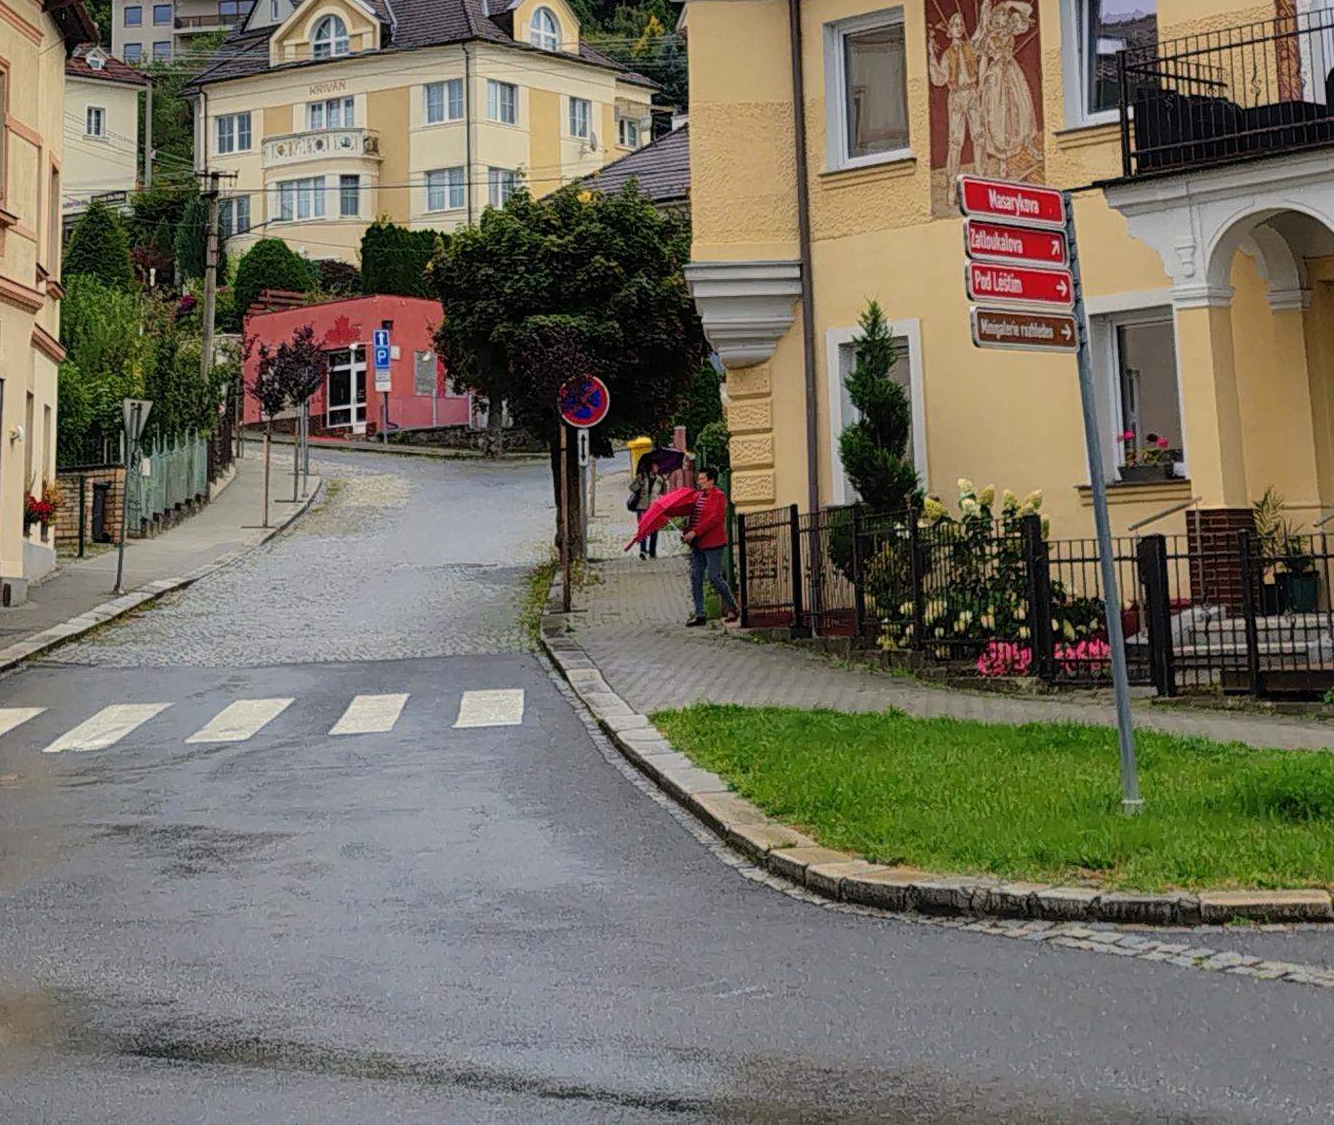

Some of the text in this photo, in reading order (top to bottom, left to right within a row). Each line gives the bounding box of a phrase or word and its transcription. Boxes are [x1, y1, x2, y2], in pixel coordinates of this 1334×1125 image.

[988, 188, 1040, 216] Masarykova
[970, 228, 1023, 254] Zatloukalova
[974, 270, 992, 291] Pod
[377, 349, 388, 364] P
